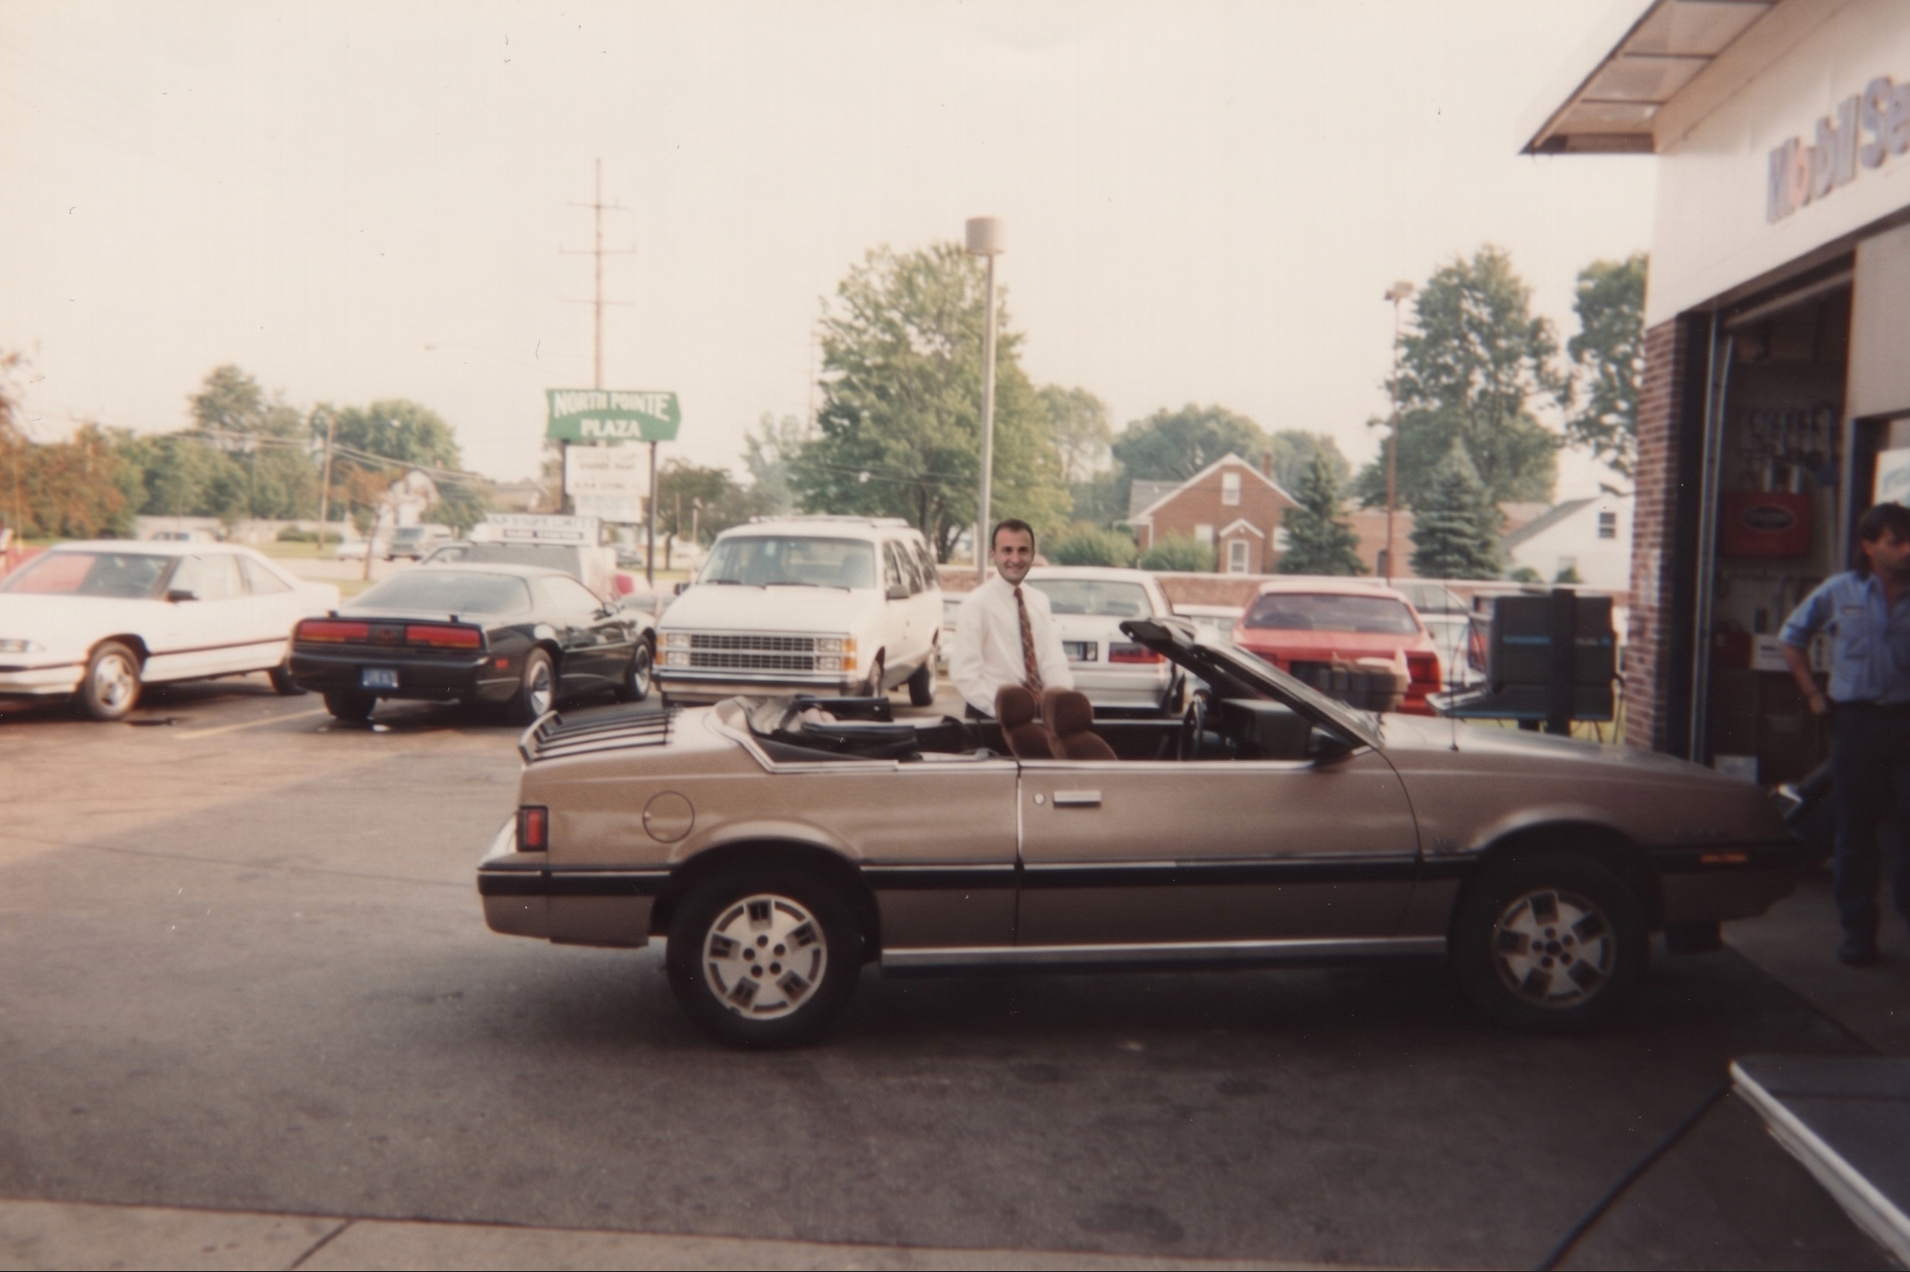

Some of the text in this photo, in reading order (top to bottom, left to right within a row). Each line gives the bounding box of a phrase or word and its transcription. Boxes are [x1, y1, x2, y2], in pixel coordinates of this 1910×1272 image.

[1766, 93, 1860, 223] Mobil
[553, 391, 670, 421] NORTH POINTE
[580, 419, 642, 437] PLAZA
